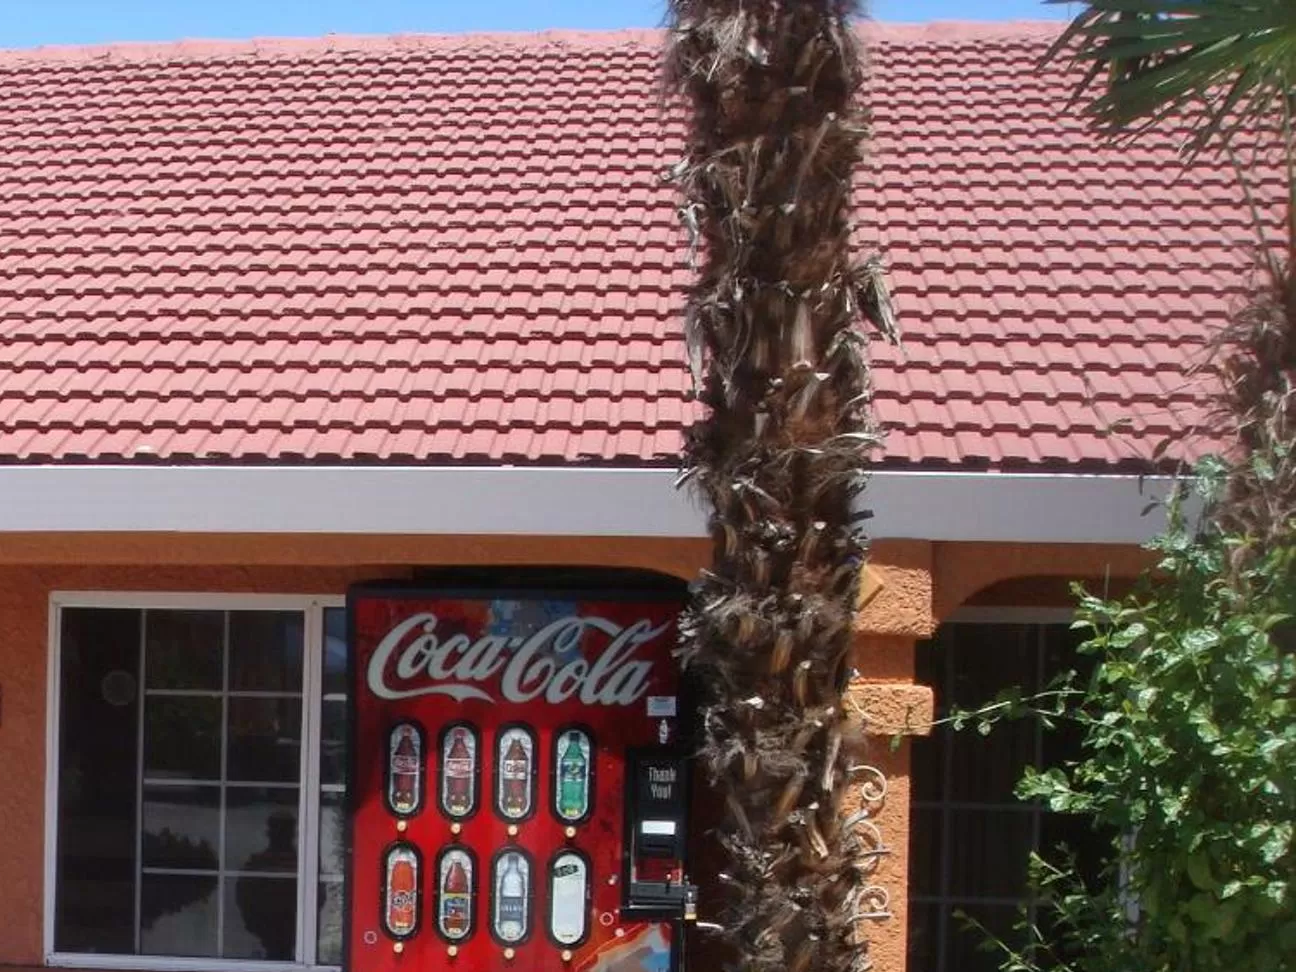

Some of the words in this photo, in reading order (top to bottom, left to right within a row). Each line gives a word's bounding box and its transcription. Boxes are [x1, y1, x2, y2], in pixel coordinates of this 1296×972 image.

[367, 612, 672, 706] Coca-Cola
[649, 766, 677, 782] Thank
[650, 783, 672, 800] You!
